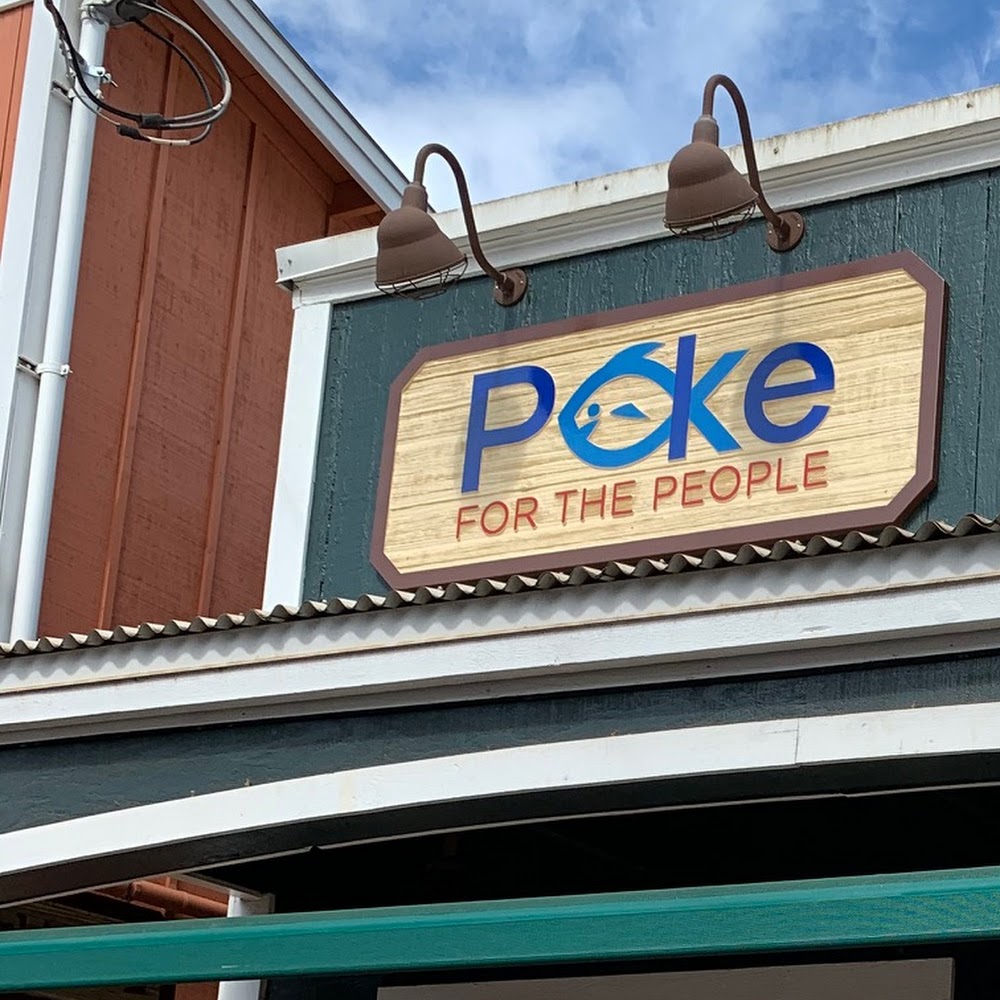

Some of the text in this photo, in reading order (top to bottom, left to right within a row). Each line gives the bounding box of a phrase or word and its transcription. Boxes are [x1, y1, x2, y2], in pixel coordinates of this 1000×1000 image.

[461, 334, 836, 494] Poke
[456, 450, 830, 541] FOR THE PEOPLE
